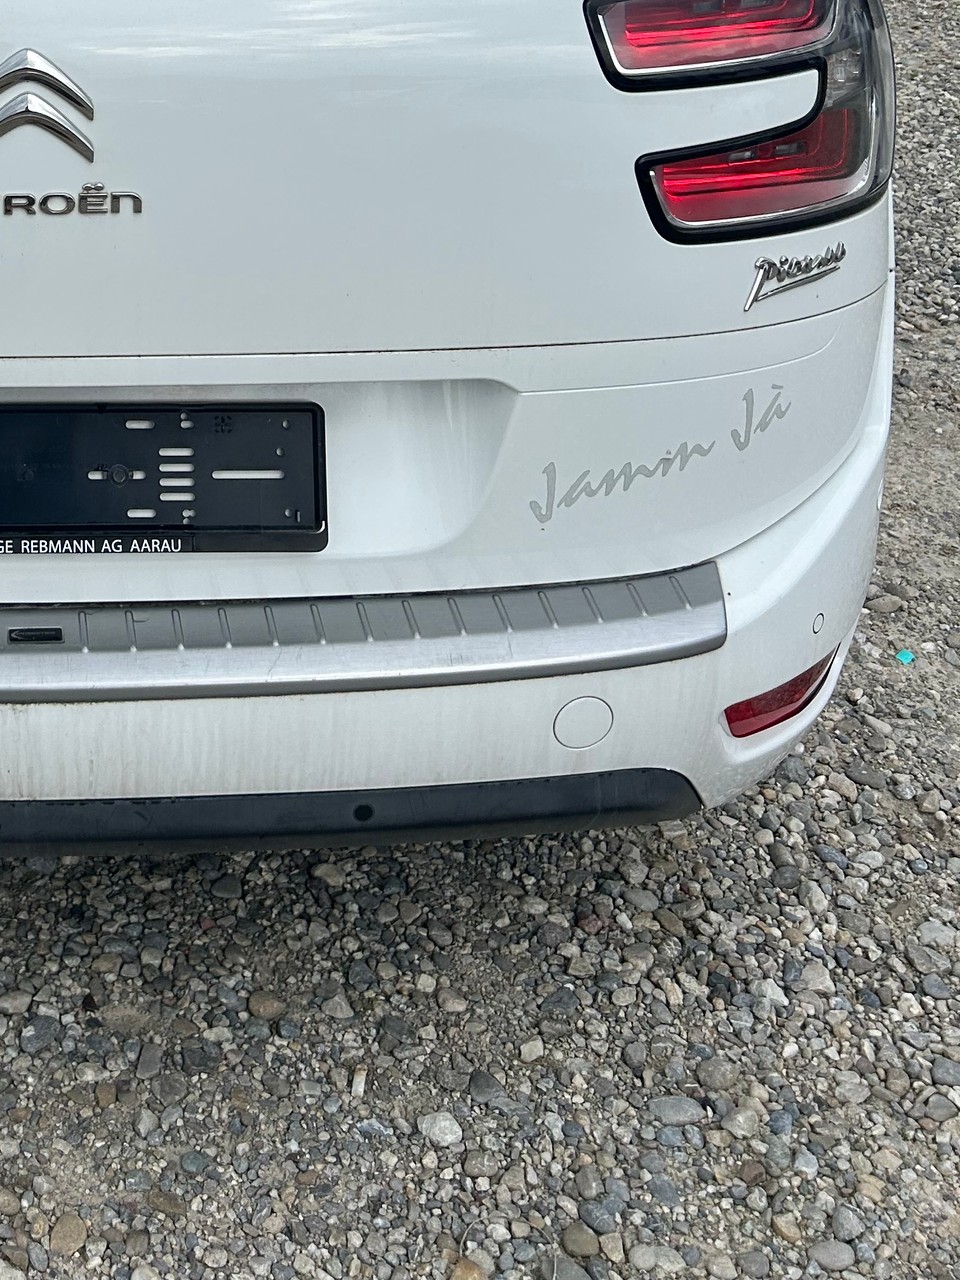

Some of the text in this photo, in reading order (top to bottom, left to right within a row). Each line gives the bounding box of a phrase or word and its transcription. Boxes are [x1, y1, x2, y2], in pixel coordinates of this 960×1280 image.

[21, 539, 95, 553] REBMANN
[101, 539, 123, 553] AG
[130, 538, 182, 553] AARAU
